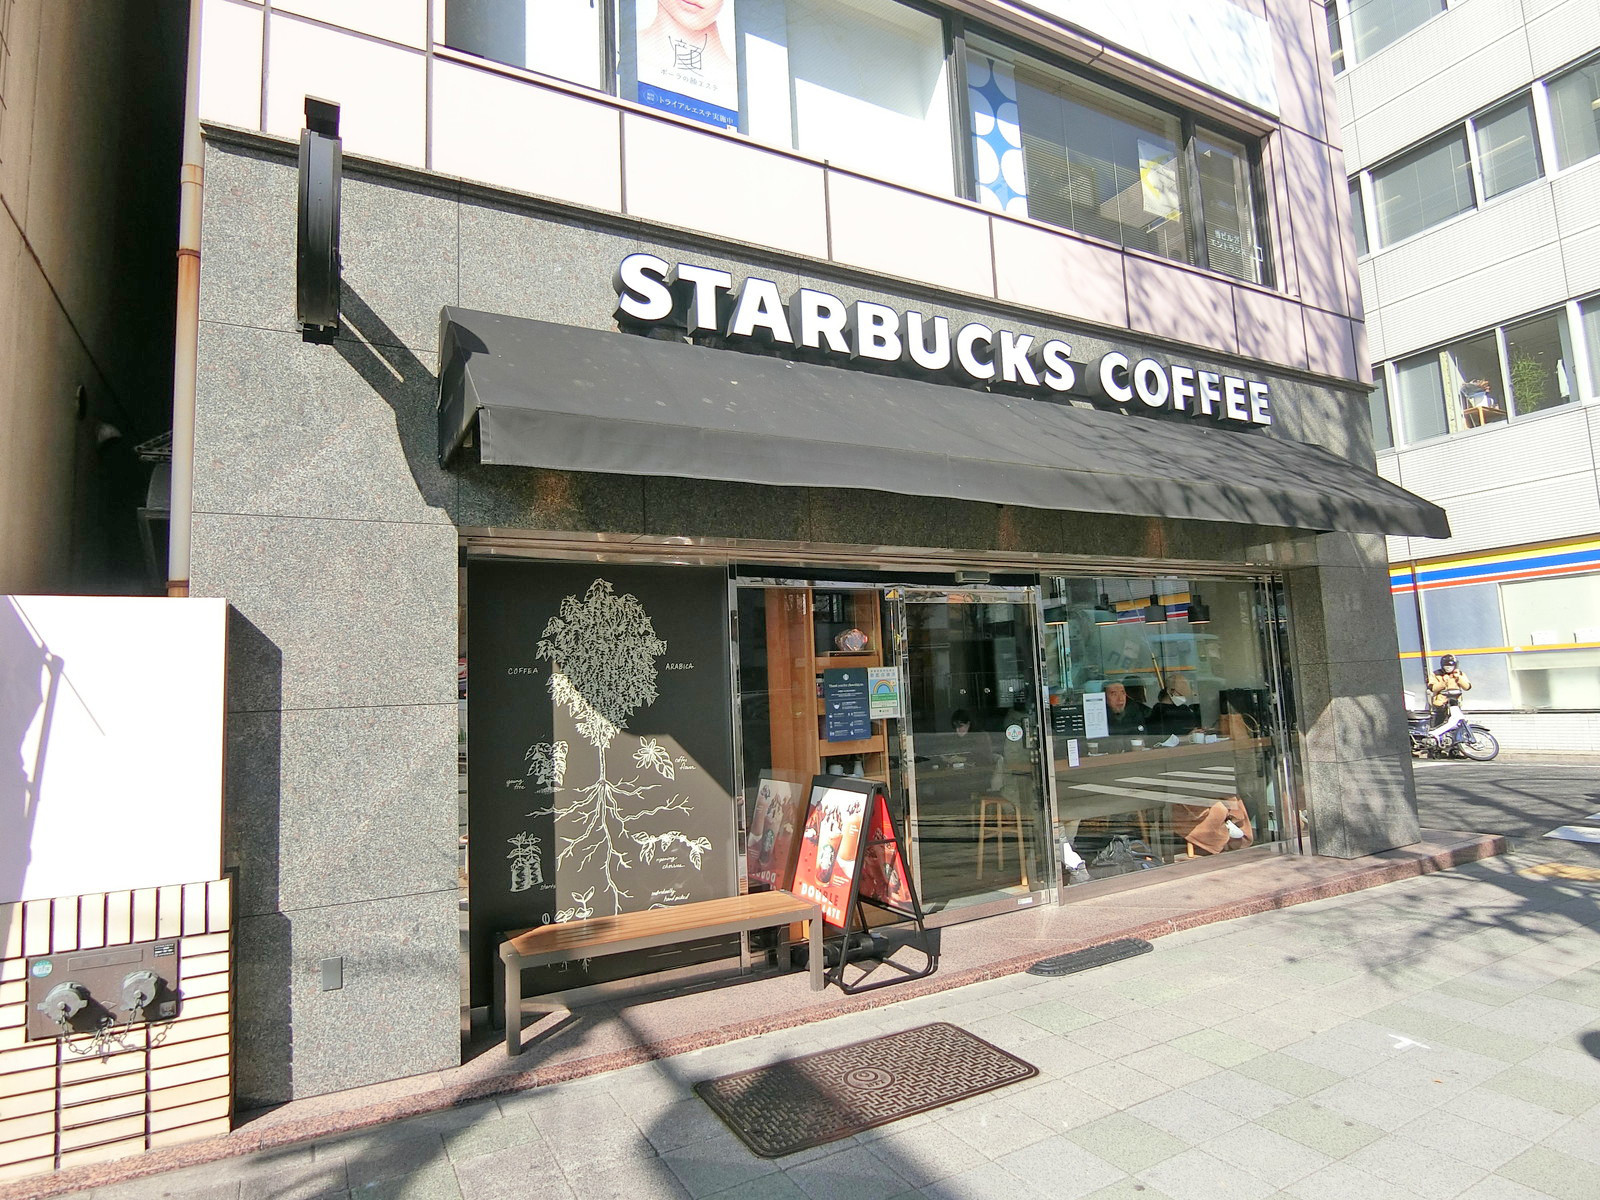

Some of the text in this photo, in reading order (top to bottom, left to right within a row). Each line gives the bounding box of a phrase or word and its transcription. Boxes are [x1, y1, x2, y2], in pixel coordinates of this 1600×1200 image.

[617, 252, 1272, 426] STARBUCKS COFFEE
[507, 666, 539, 675] COFFEA
[665, 662, 695, 671] ARABICA
